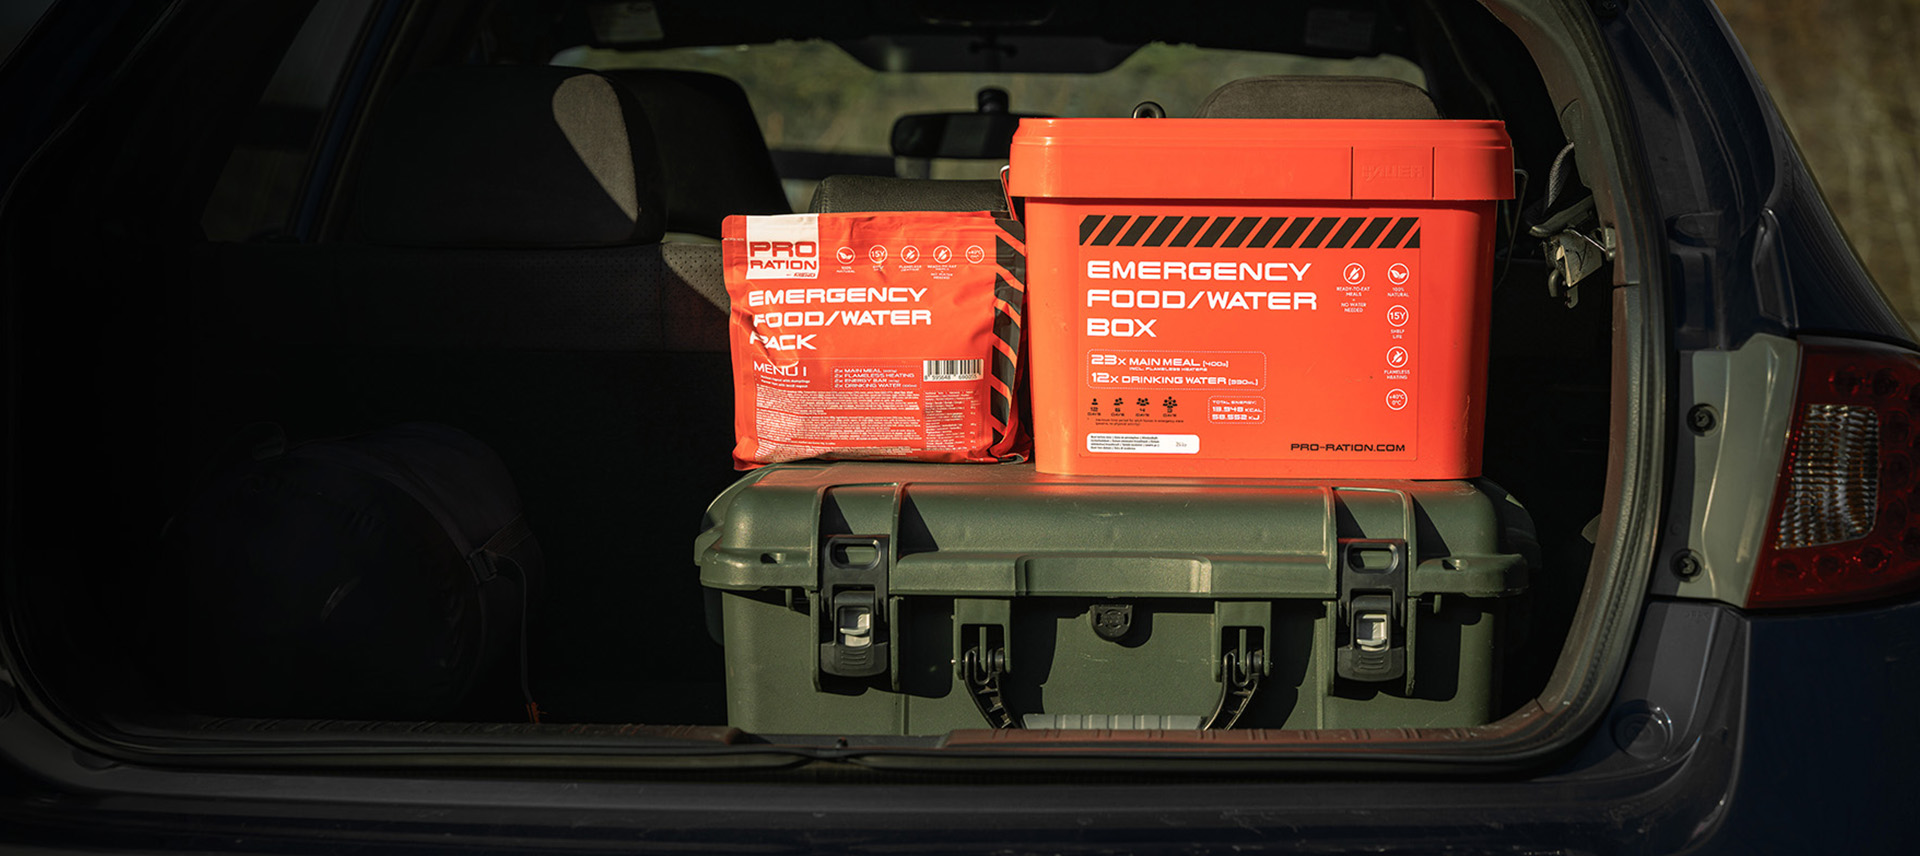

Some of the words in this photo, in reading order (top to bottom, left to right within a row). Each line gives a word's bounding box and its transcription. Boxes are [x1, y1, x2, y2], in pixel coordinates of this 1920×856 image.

[749, 241, 817, 257] PRO
[750, 260, 817, 270] RATION
[1087, 260, 1312, 281] EMERGENCY
[749, 287, 928, 307] EMERGENCY
[1087, 289, 1318, 310] FOOD/WATER
[753, 310, 932, 328] FOOD/WATER
[1390, 312, 1406, 320] 15Y
[1087, 318, 1157, 338] BOX
[750, 332, 817, 351] PACK
[753, 360, 798, 376] MENU
[1129, 358, 1160, 366] MAIN
[1162, 358, 1201, 366] MEAL
[1121, 375, 1183, 384] DRINKING
[1290, 443, 1406, 452] PRO-RATION.COM
